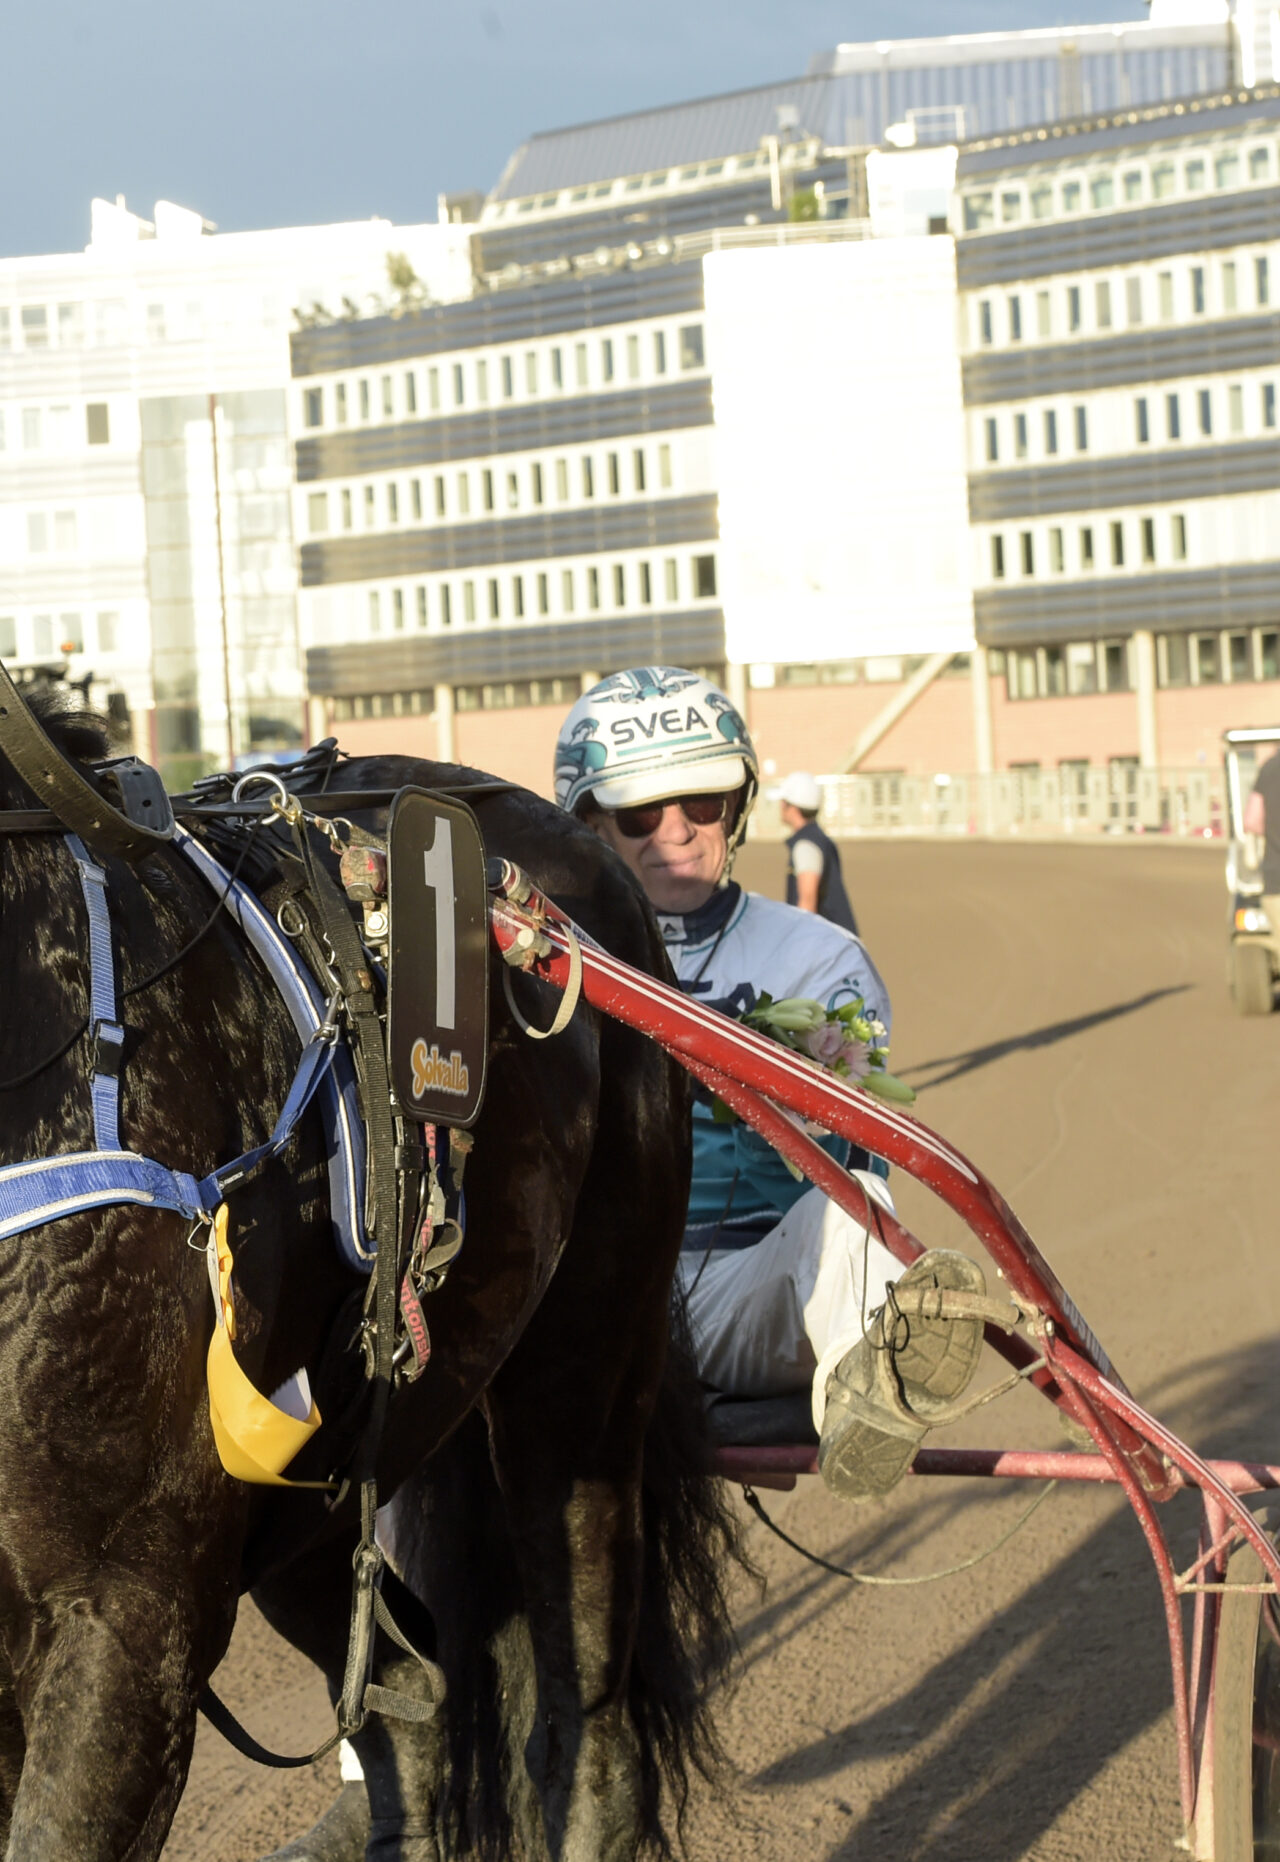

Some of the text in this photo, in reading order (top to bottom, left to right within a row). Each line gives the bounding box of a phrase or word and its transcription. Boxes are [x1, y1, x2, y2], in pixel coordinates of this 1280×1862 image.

[610, 706, 709, 746] SVEA
[423, 815, 456, 1030] 1
[411, 1038, 469, 1098] Solvalla
